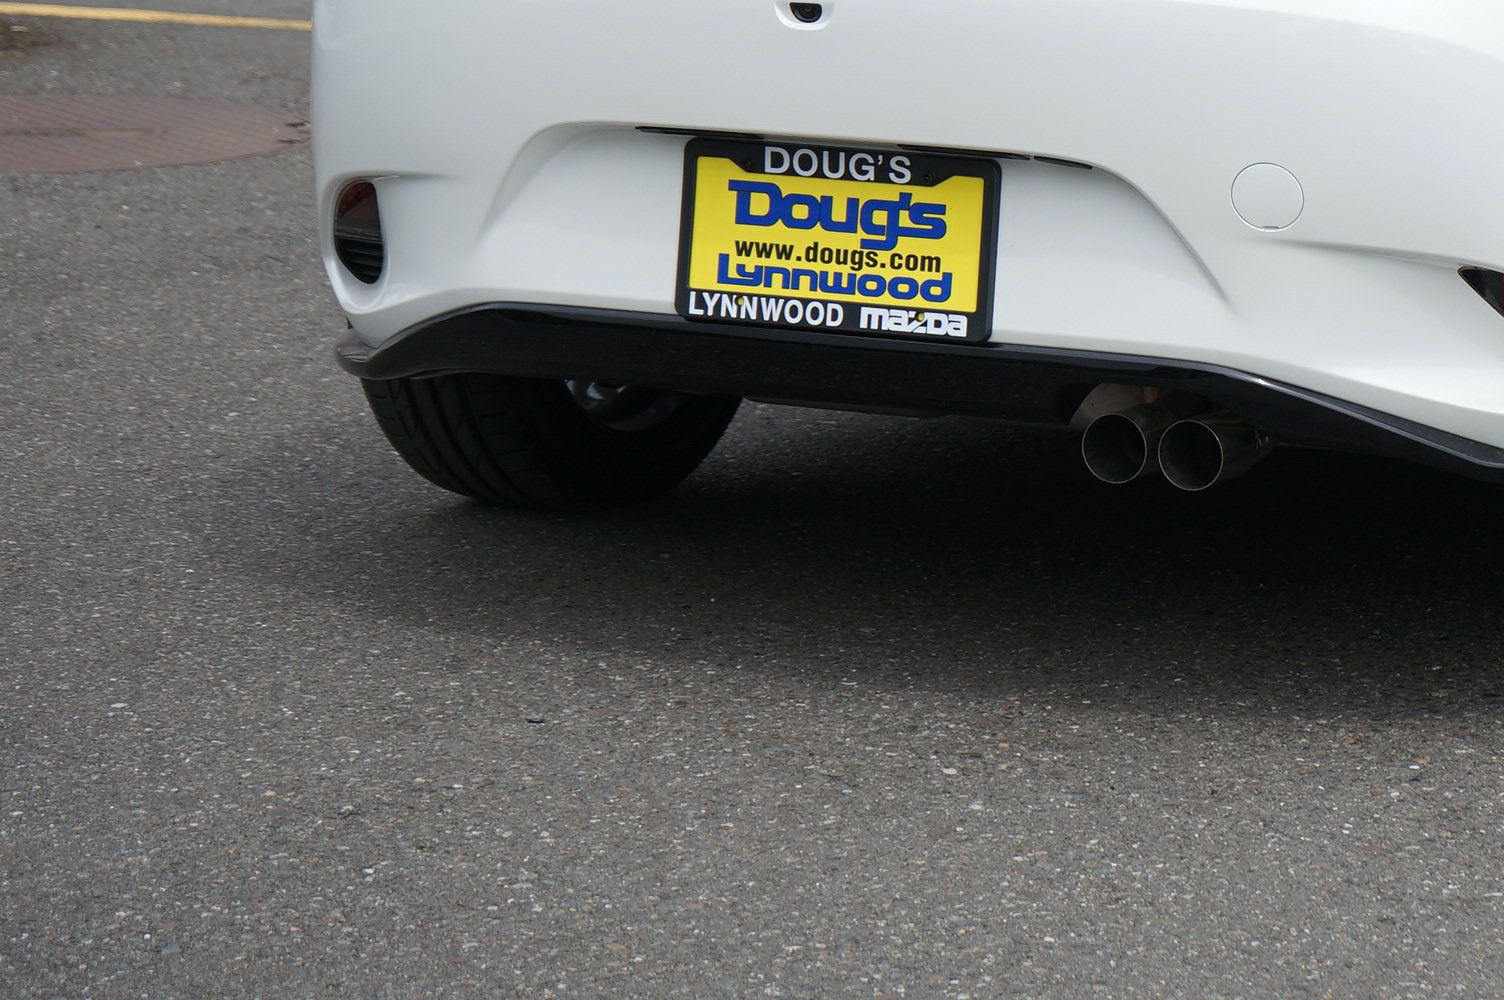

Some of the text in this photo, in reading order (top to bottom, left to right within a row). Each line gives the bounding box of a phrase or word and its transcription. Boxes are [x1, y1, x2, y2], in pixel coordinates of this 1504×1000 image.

[763, 146, 911, 183] DOUG'S
[735, 240, 941, 272] www.dougs.com
[717, 253, 953, 303] Lynnwood
[688, 291, 844, 327] LYNNWOOD
